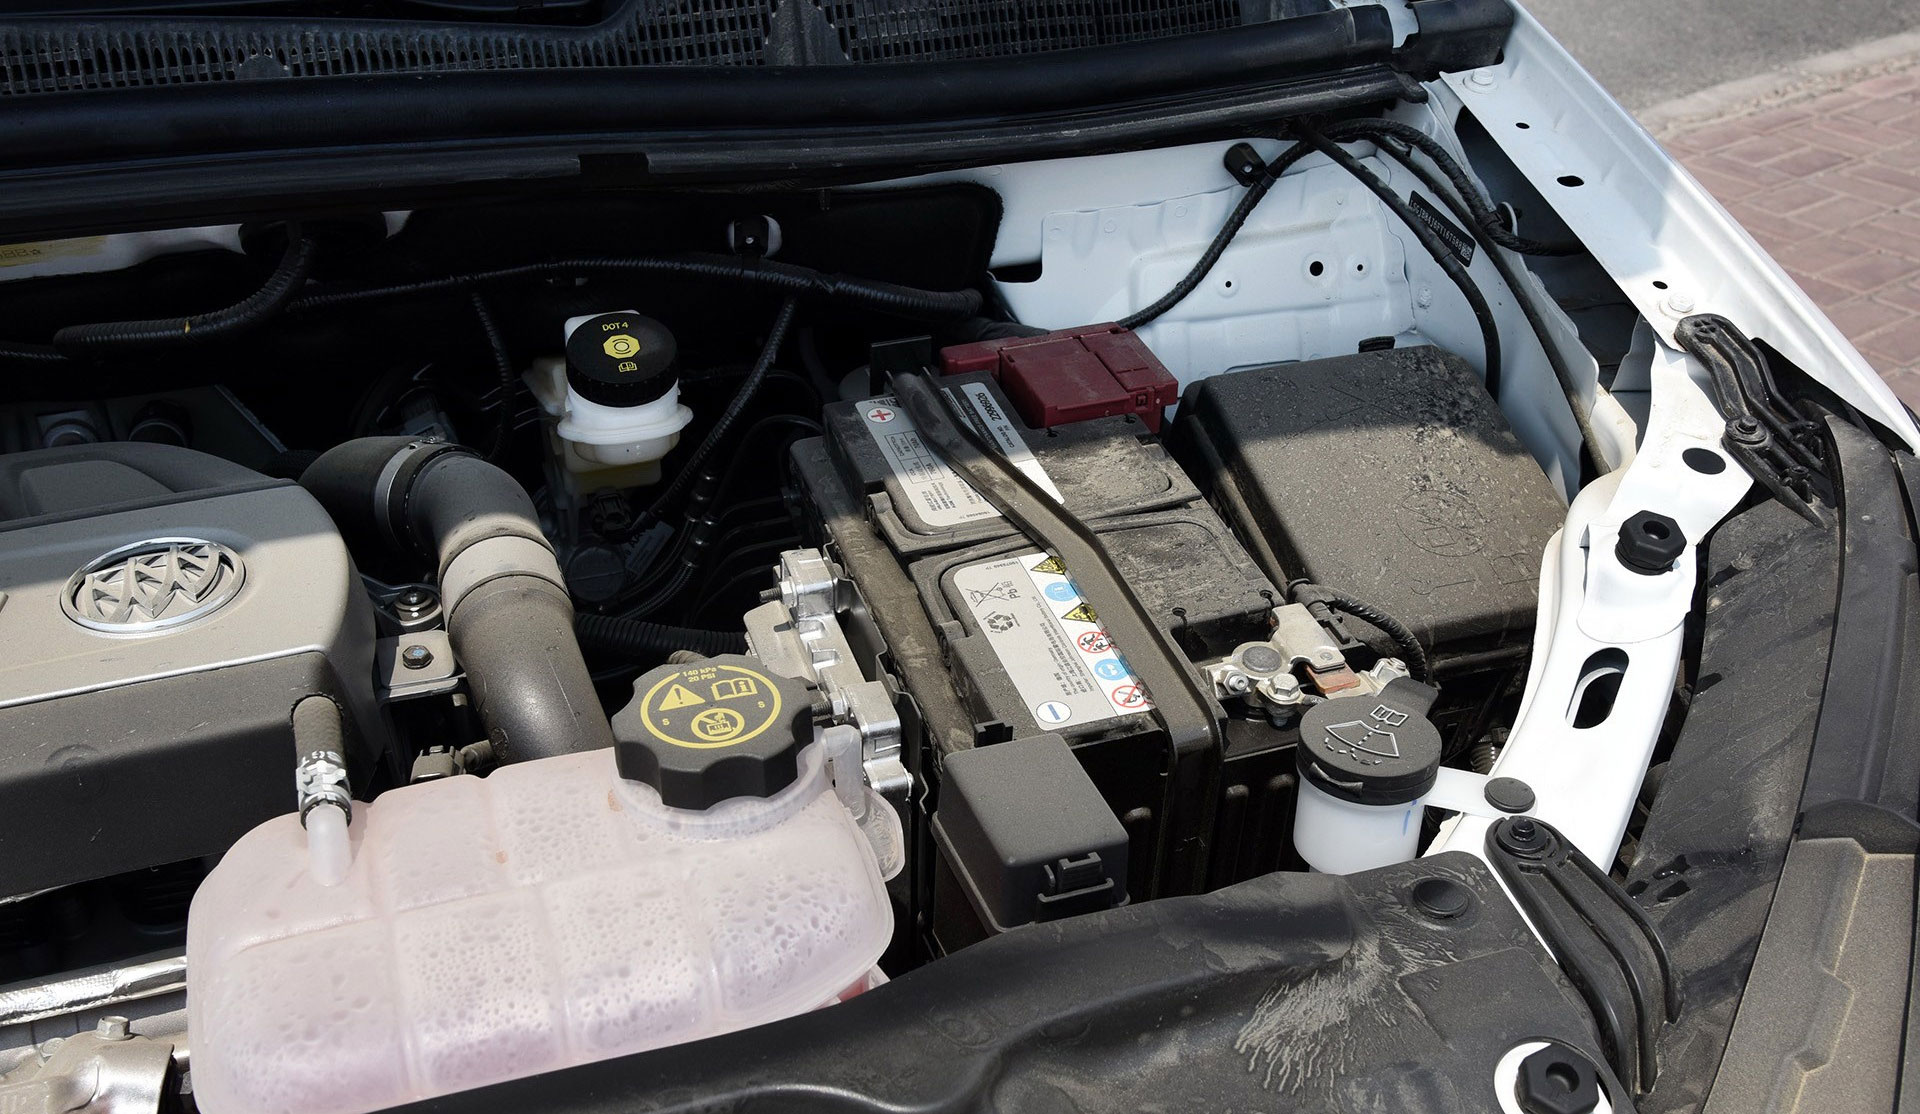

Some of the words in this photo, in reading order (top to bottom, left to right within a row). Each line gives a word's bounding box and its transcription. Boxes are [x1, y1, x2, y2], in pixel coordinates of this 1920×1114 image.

[602, 322, 620, 331] DOT
[975, 392, 1002, 422] 22996926
[1008, 588, 1020, 599] Pb
[682, 669, 698, 677] 140
[700, 666, 717, 674] kPa
